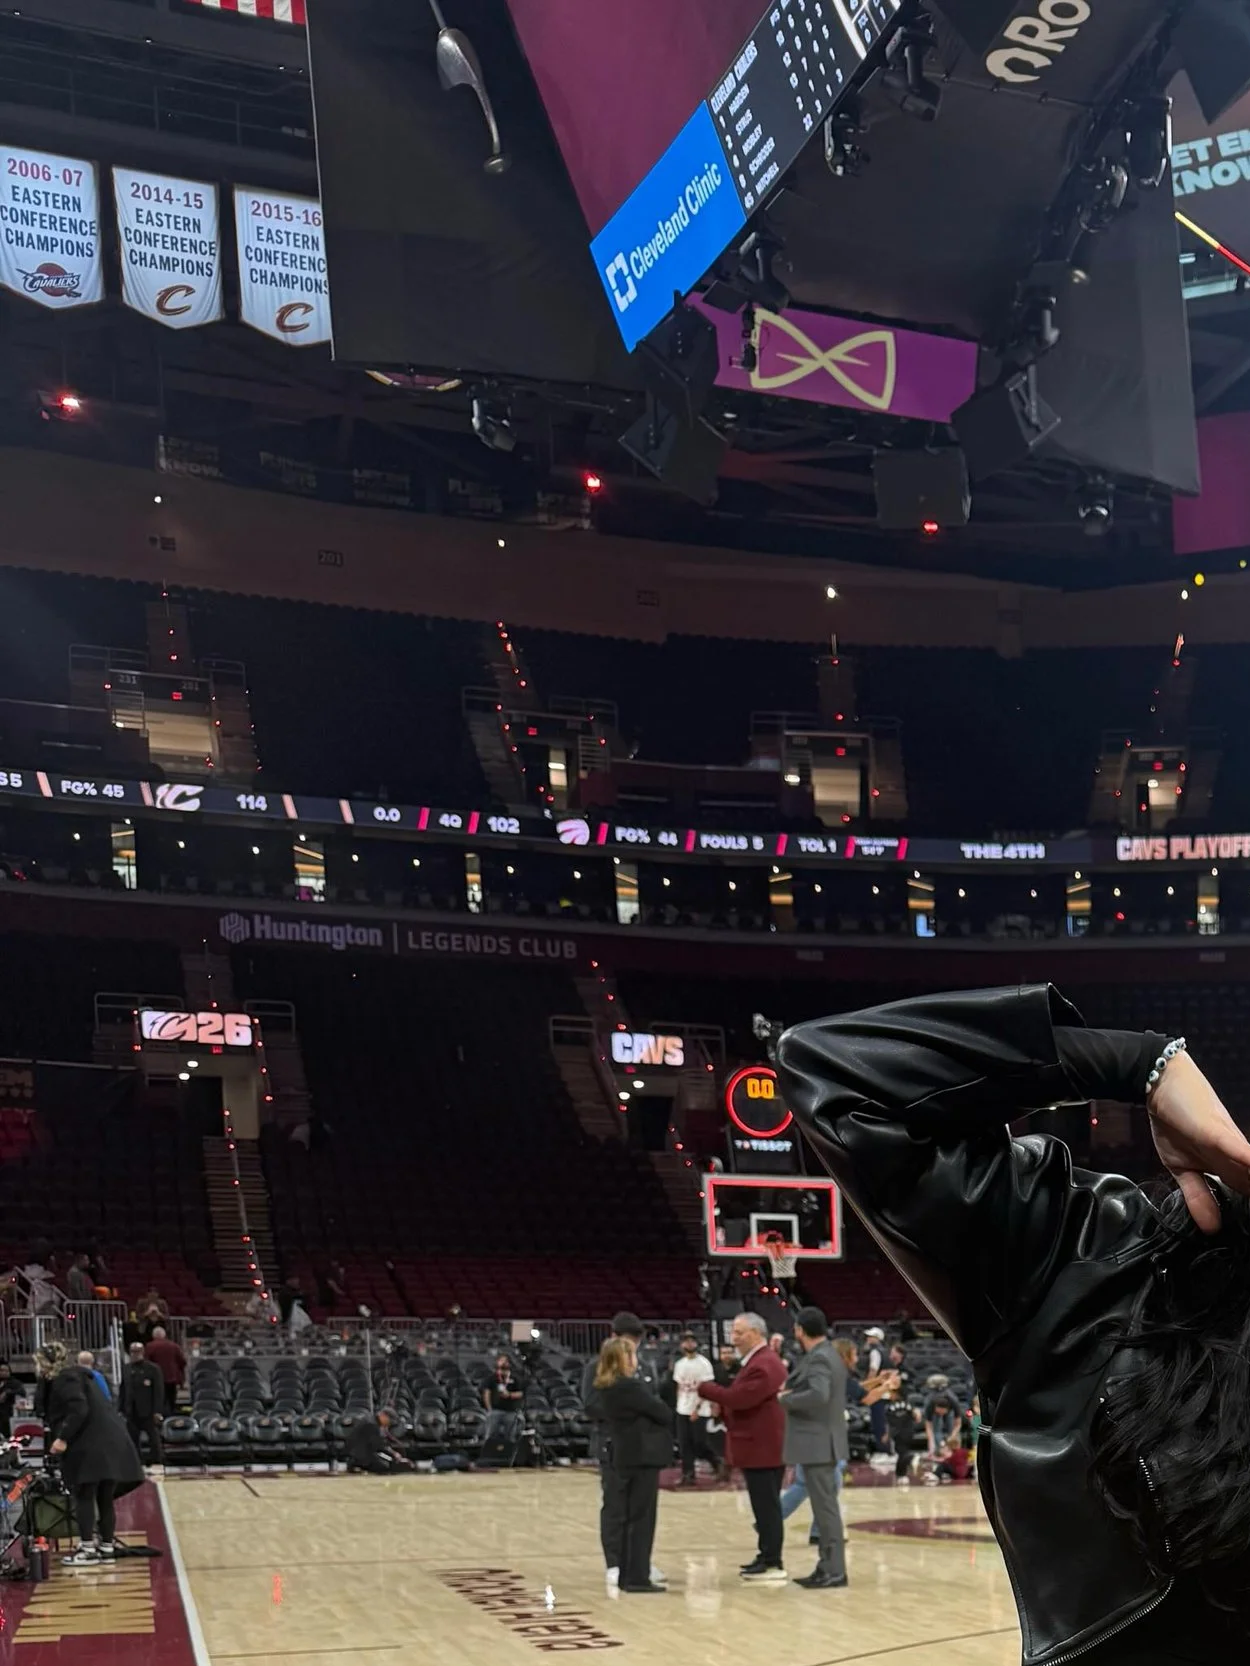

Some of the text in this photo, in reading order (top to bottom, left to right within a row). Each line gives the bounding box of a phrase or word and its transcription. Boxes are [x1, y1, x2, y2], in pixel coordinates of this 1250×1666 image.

[1171, 137, 1213, 168] ET
[7, 158, 83, 187] 2006-07
[11, 185, 81, 213] EASTERN
[131, 182, 204, 209] 2014-15
[0, 205, 97, 237] CONFERENCE
[135, 208, 201, 234] EASTERN
[251, 200, 322, 226] 2015-16
[630, 163, 721, 279] Cleveland Clinic
[5, 228, 95, 258] CHAMPIONS
[124, 226, 217, 256] CONFERENCE
[256, 226, 319, 251] EASTERN
[129, 249, 214, 277] CHAMPIONS
[245, 245, 326, 273] CONFERENC
[61, 780, 125, 798] FG% 45
[236, 794, 267, 811] 114
[373, 806, 401, 822] 0.0
[438, 813, 462, 828] 4Q
[487, 816, 520, 834] 102
[700, 834, 747, 850] FOULS
[1116, 836, 1167, 861] CAVS
[254, 914, 577, 959] Huntington LEGENDS CLUB
[612, 1032, 684, 1066] CAVS
[752, 1141, 793, 1152] TISSOT
